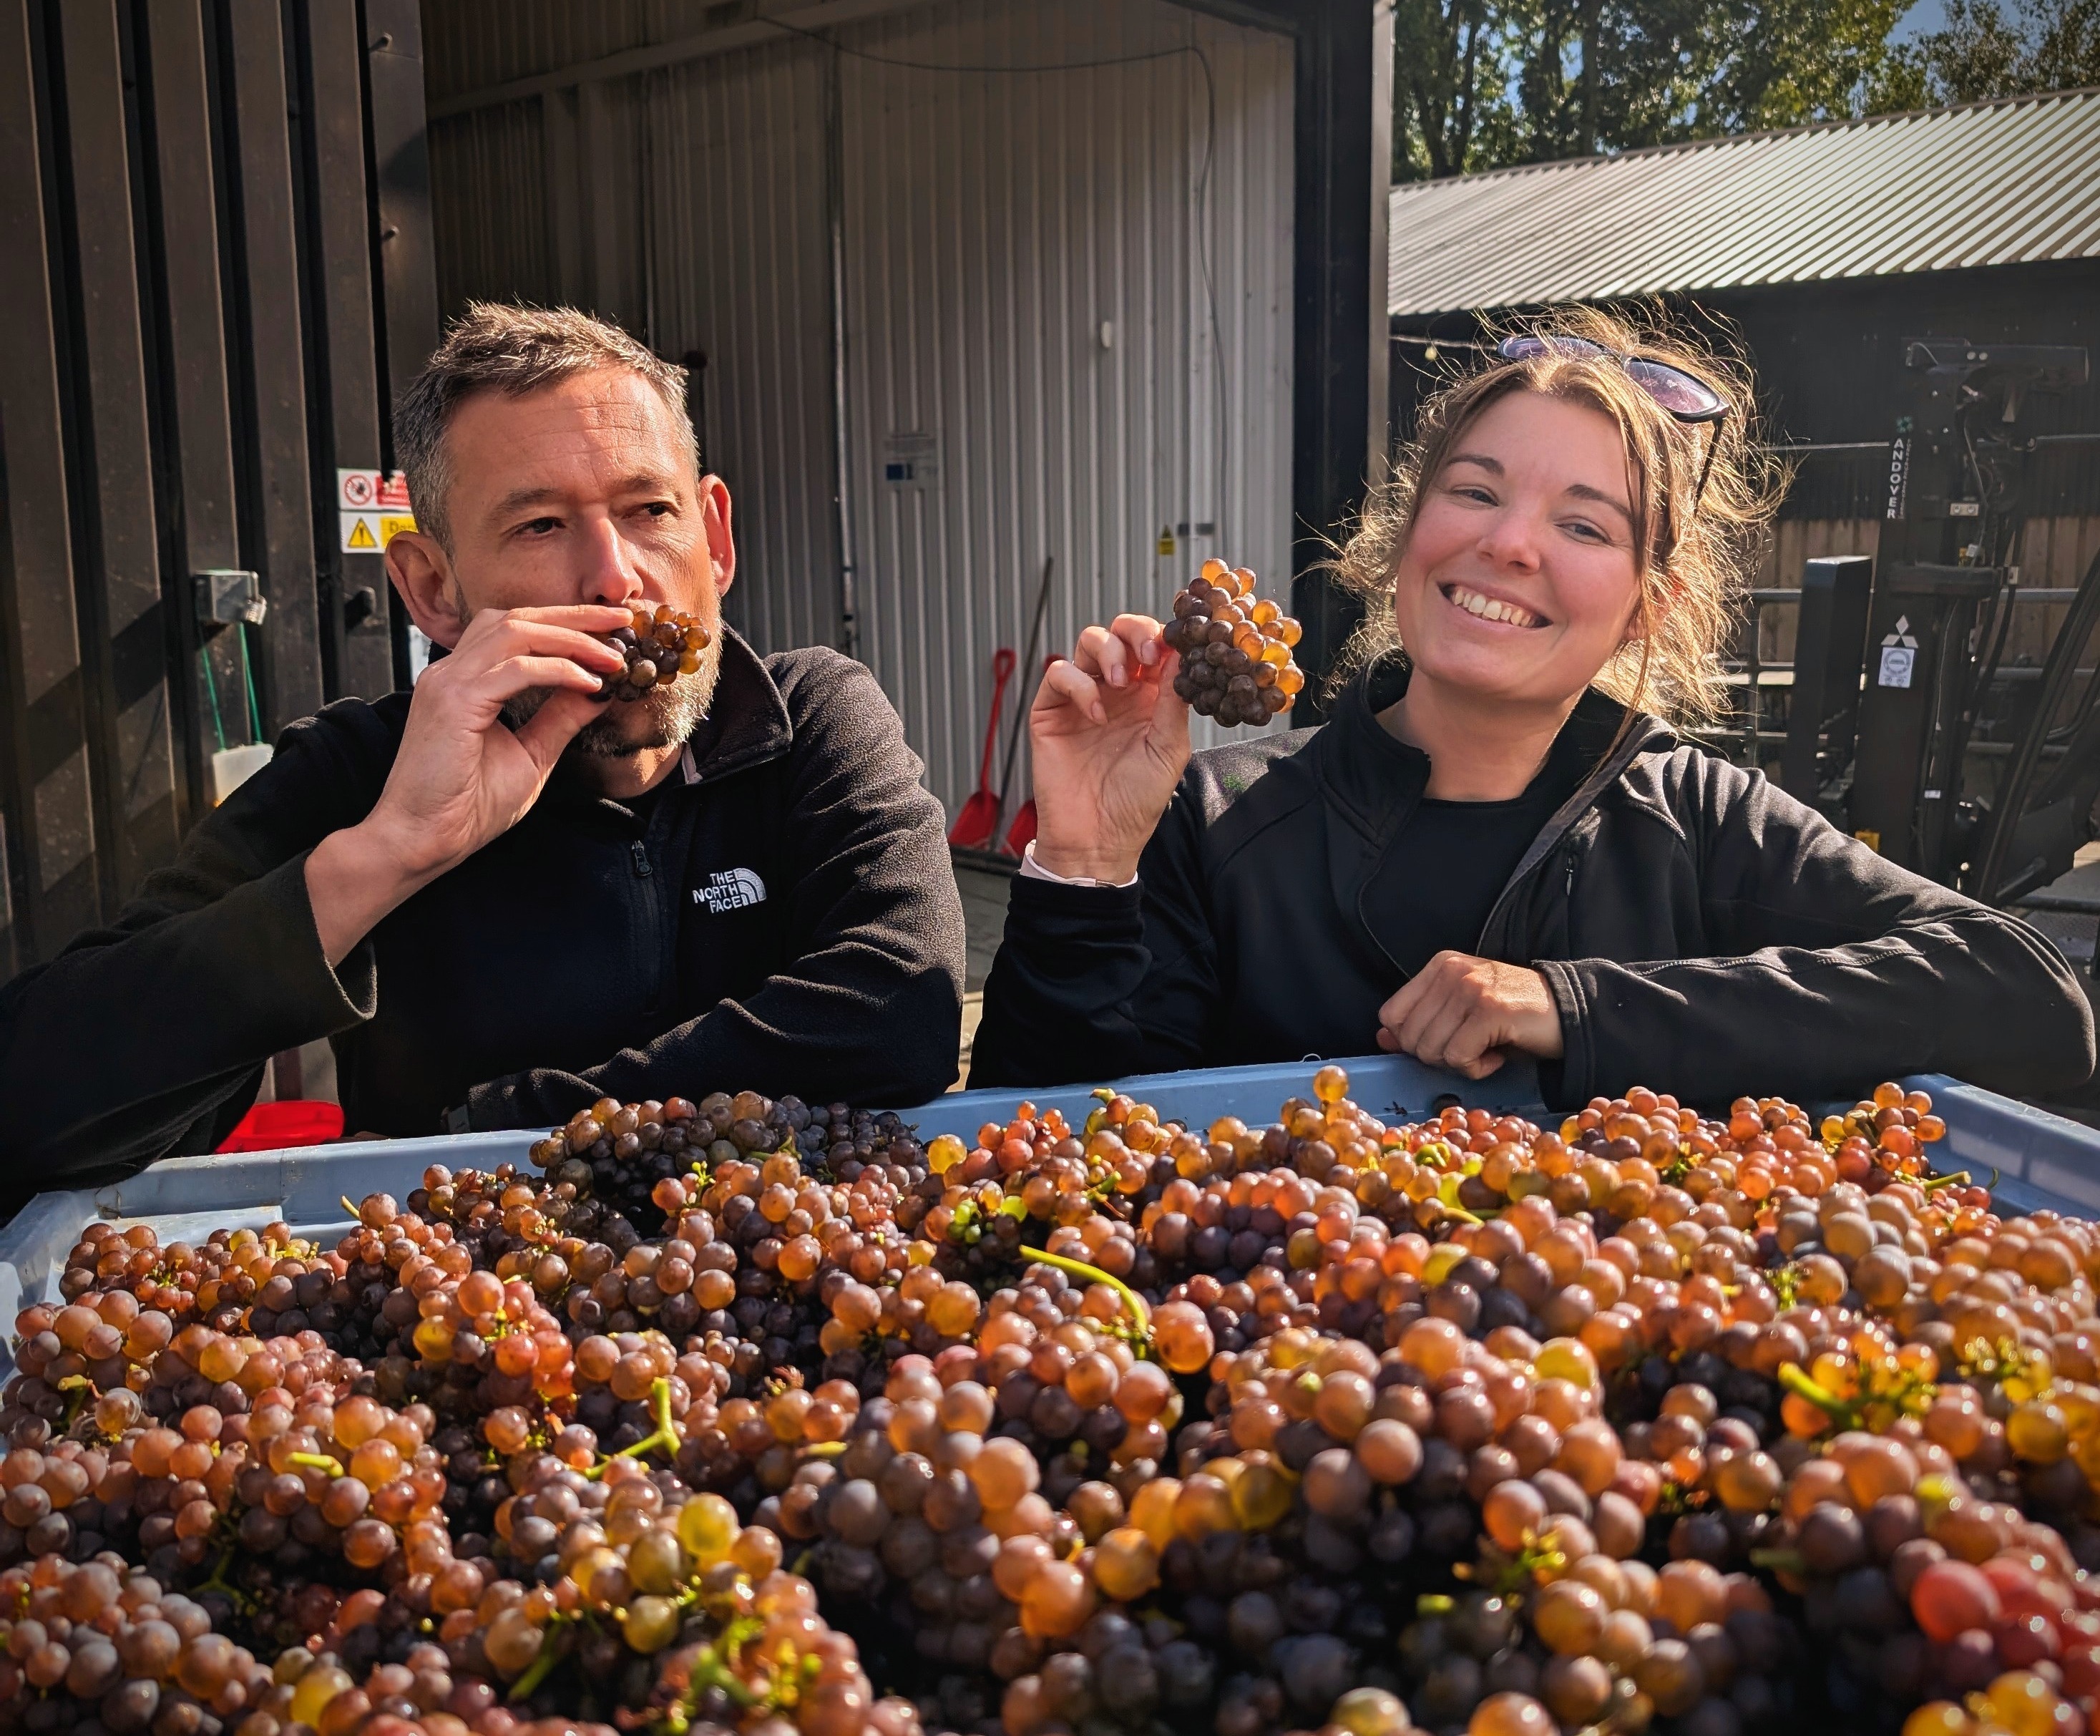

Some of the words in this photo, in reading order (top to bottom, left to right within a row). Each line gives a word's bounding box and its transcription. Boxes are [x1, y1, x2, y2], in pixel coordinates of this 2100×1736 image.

[1887, 438, 1904, 519] ANDOVER
[710, 871, 735, 886] THE
[692, 884, 738, 904] NORTH
[709, 896, 743, 914] FACE
